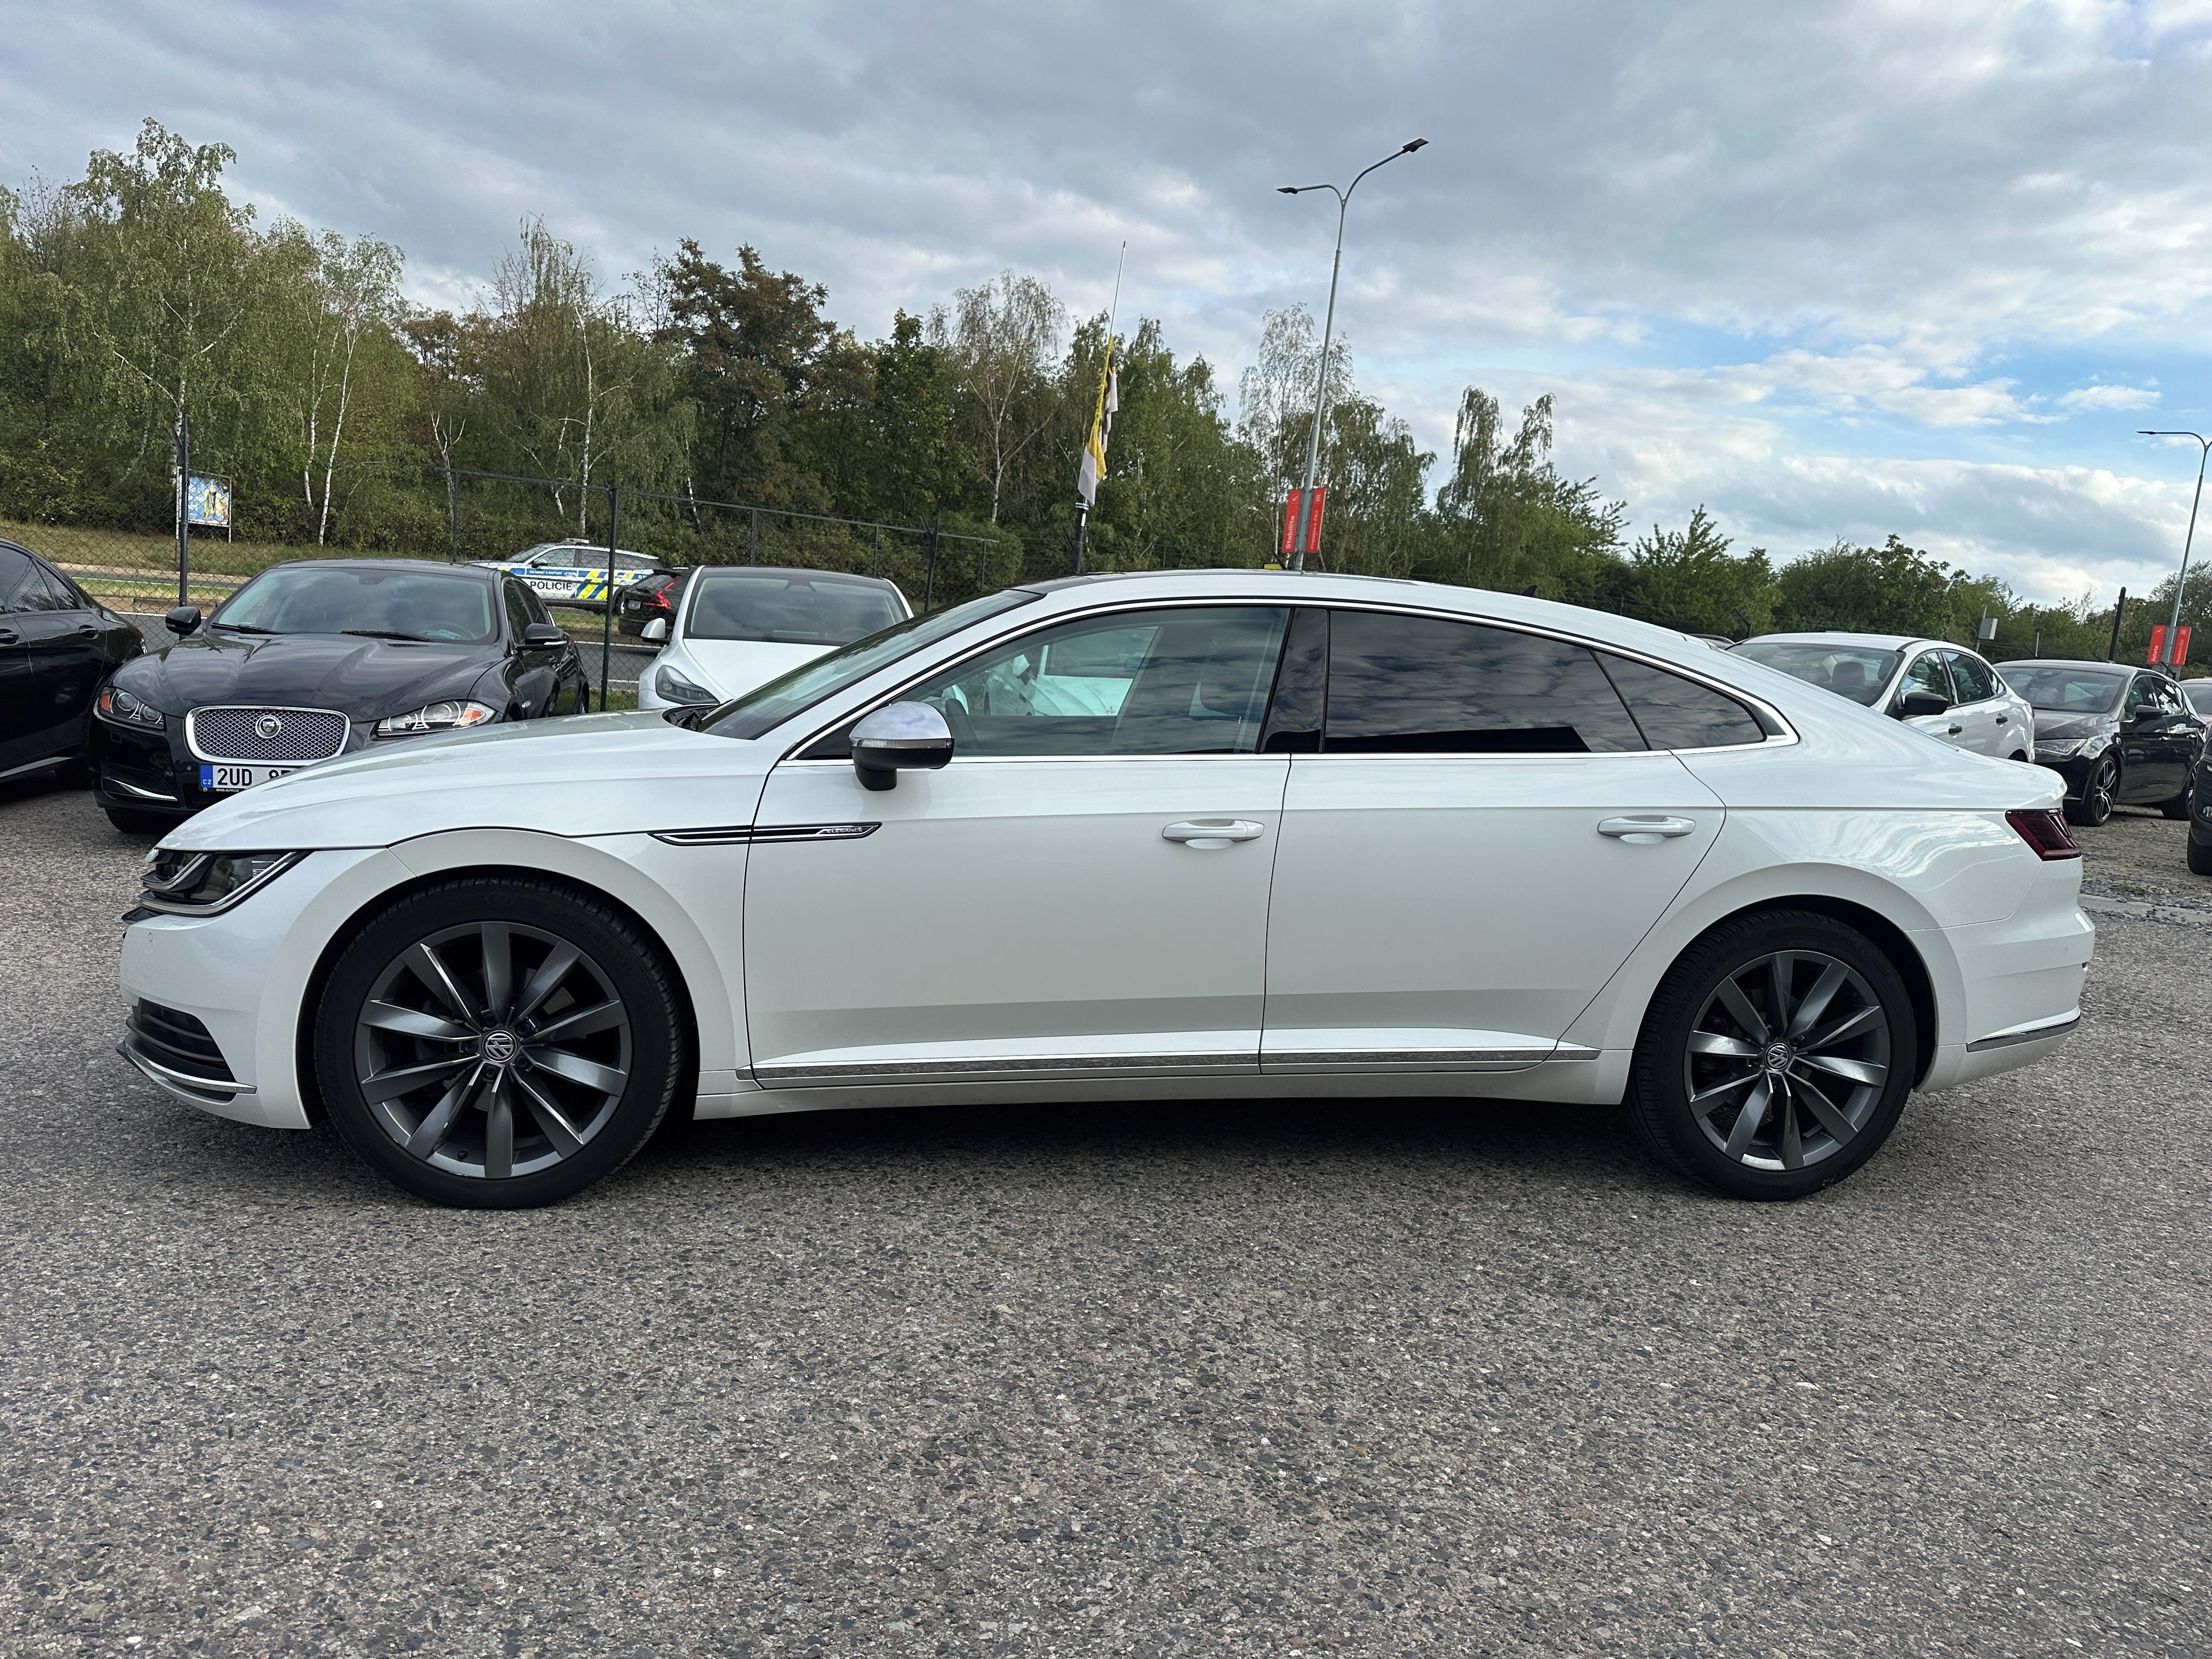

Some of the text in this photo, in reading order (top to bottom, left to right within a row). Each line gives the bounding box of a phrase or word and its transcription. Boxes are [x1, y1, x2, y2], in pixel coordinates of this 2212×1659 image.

[1285, 515, 1295, 549] Stabilita
[530, 581, 572, 591] POLICIE
[2151, 645, 2159, 663] Jistota
[217, 768, 252, 786] 2UD
